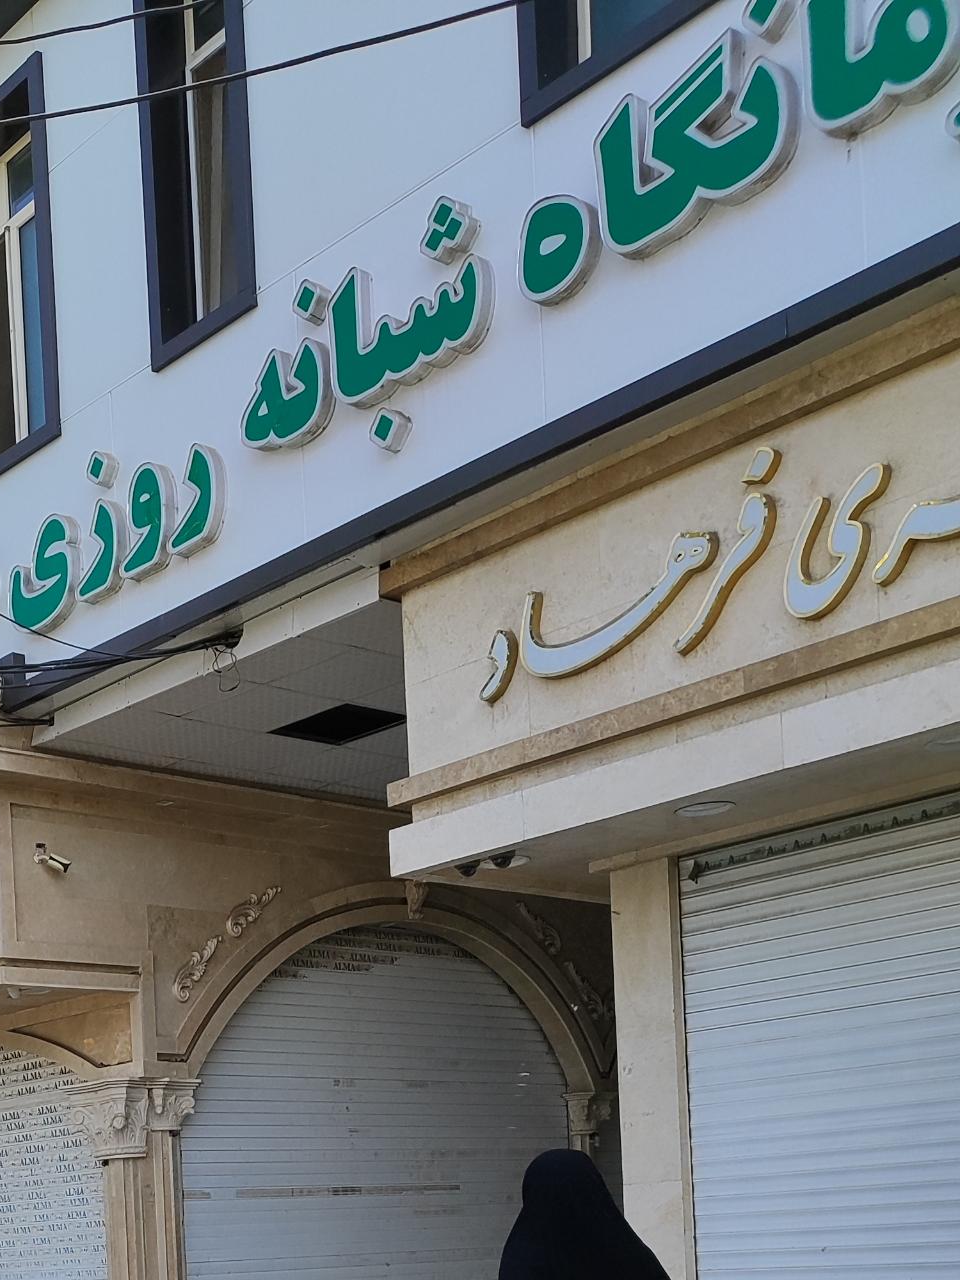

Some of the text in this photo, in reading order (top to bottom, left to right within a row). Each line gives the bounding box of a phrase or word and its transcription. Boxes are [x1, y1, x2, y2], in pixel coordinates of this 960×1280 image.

[517, 0, 960, 305] مانگاه
[242, 196, 494, 452] شبانه
[9, 442, 226, 631] روزی
[479, 447, 782, 703] فرهاد
